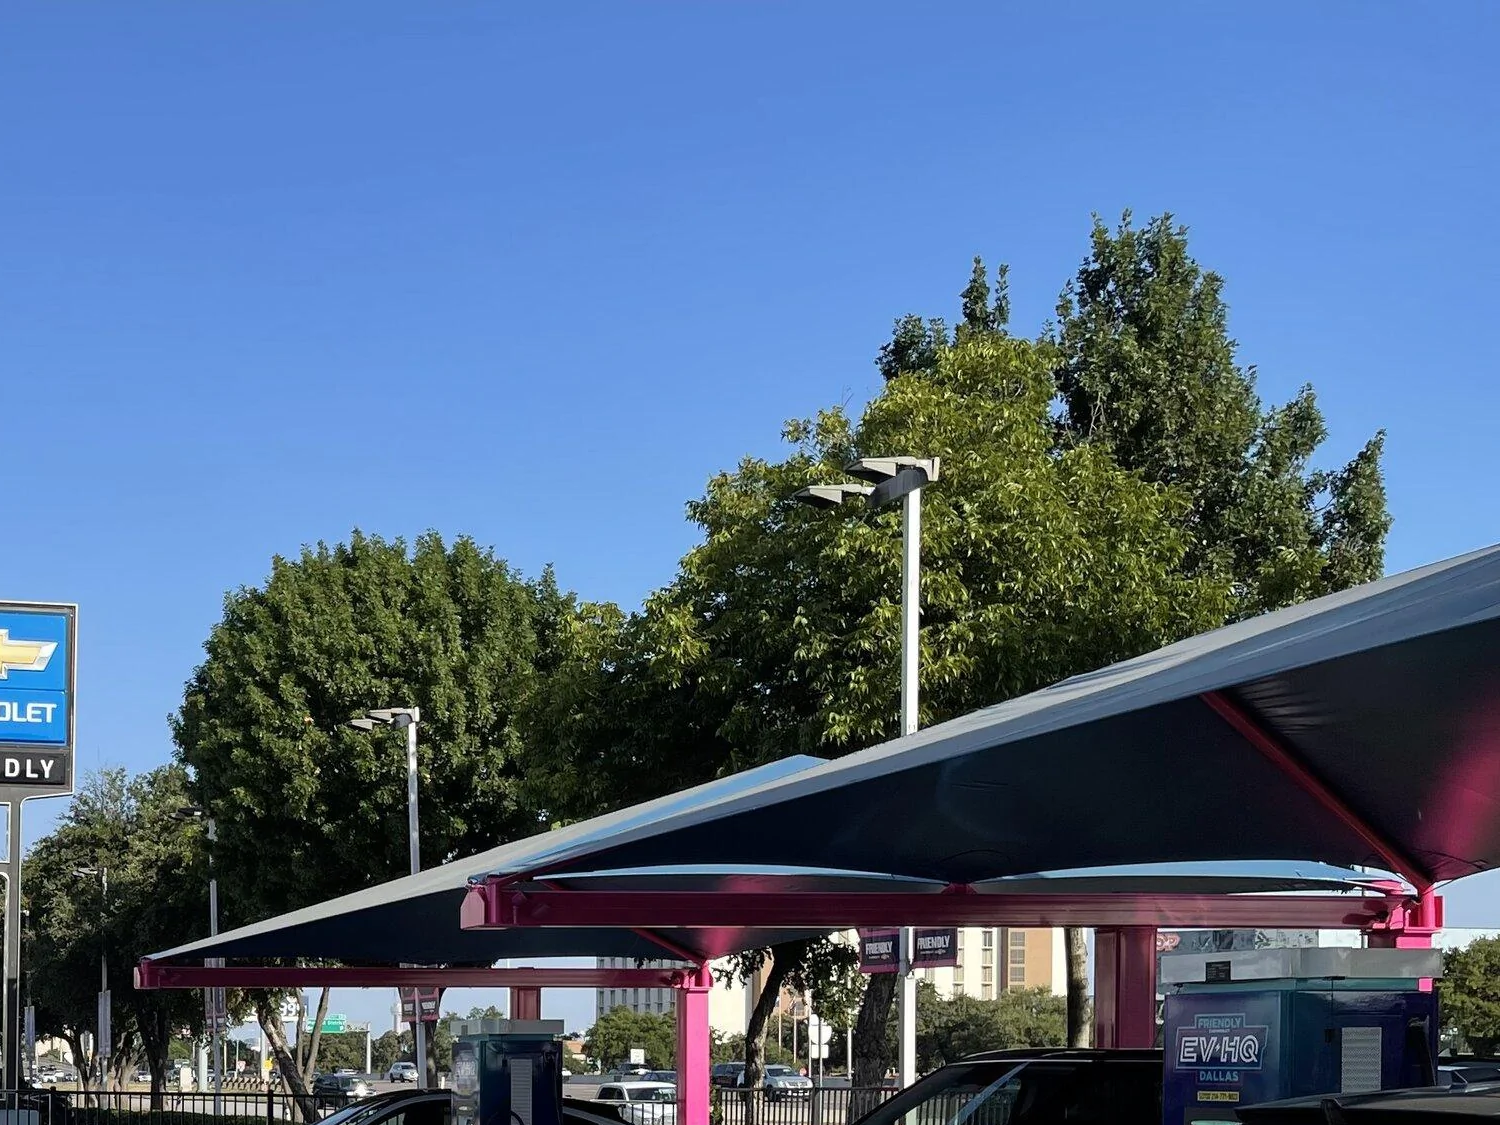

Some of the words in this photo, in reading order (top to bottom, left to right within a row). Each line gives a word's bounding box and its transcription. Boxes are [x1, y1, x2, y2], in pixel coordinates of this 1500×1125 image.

[865, 941, 893, 955] FRIENDLY
[917, 935, 950, 950] FRIENDLY
[1197, 1018, 1242, 1029] FRIENDLY
[1199, 1070, 1239, 1082] DALLAS
